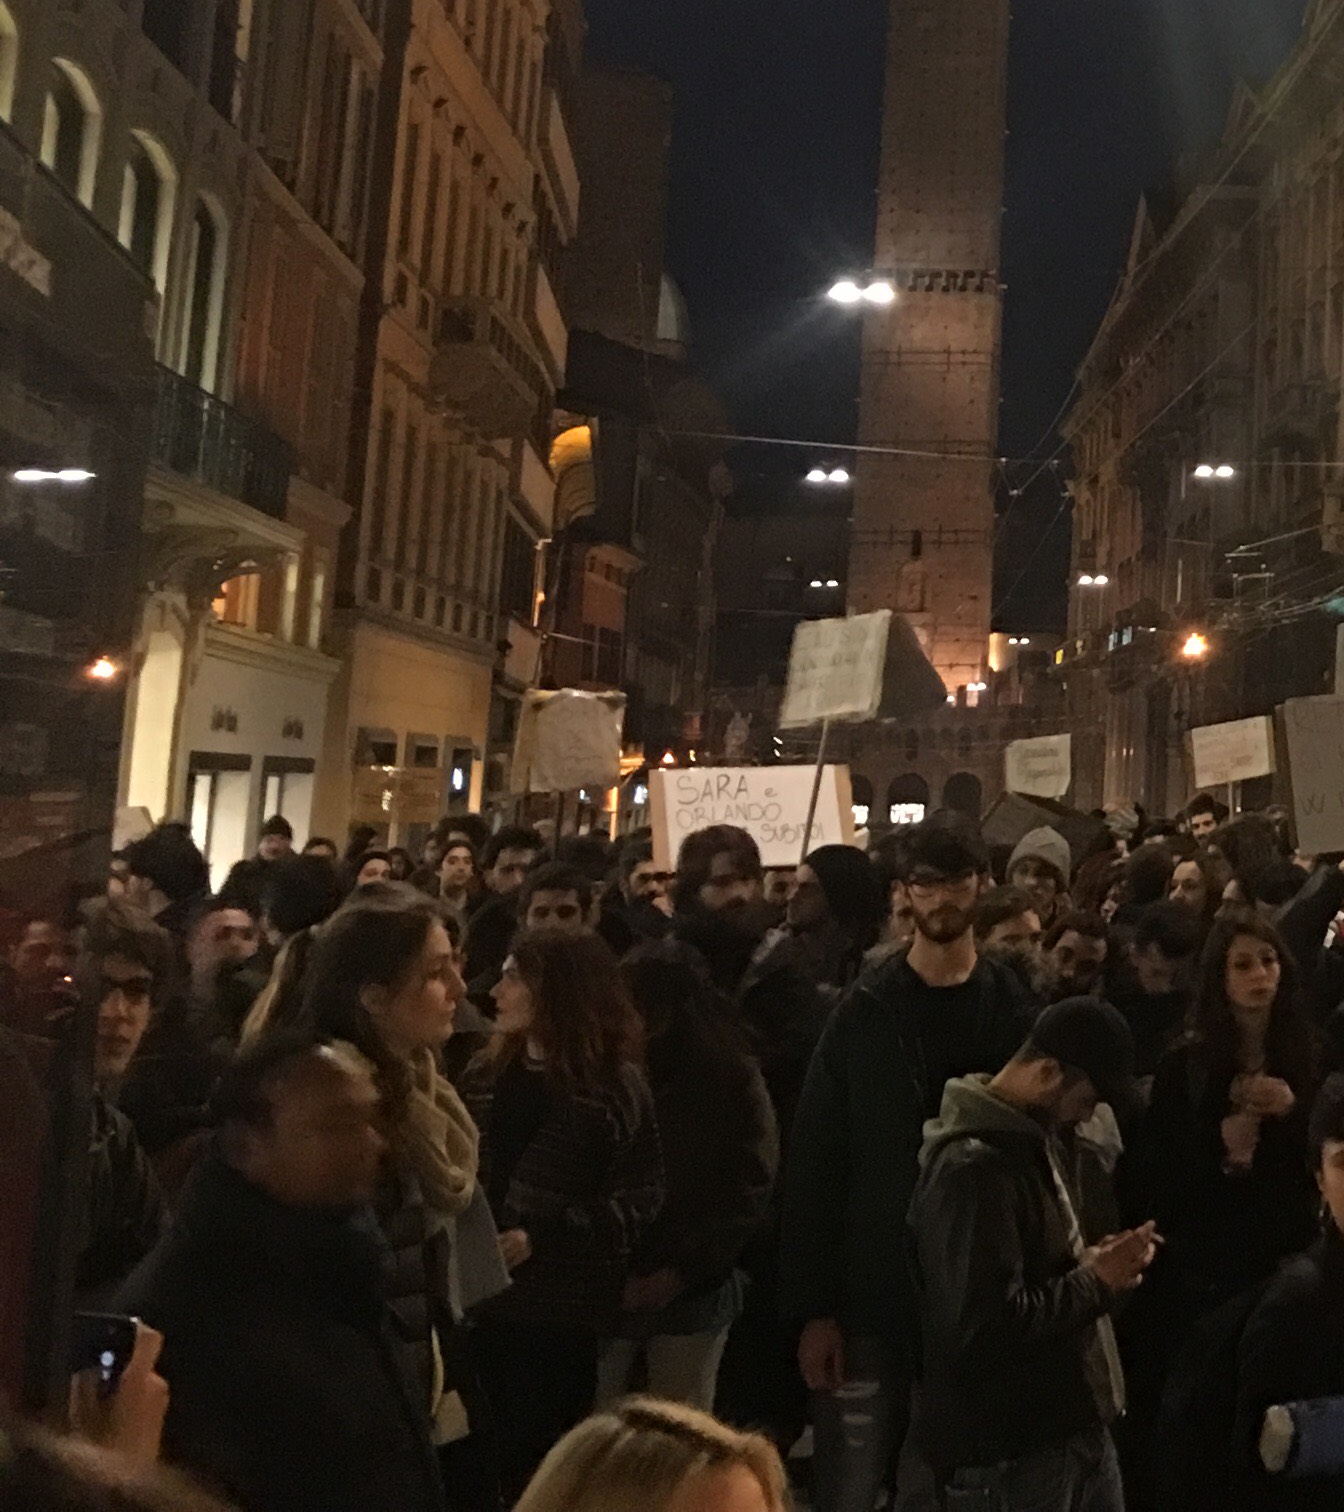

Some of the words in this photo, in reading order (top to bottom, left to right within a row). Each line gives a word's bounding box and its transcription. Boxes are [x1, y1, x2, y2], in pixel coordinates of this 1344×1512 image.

[676, 774, 750, 805] SARA
[763, 787, 779, 798] e
[675, 802, 781, 830] ORLANDO
